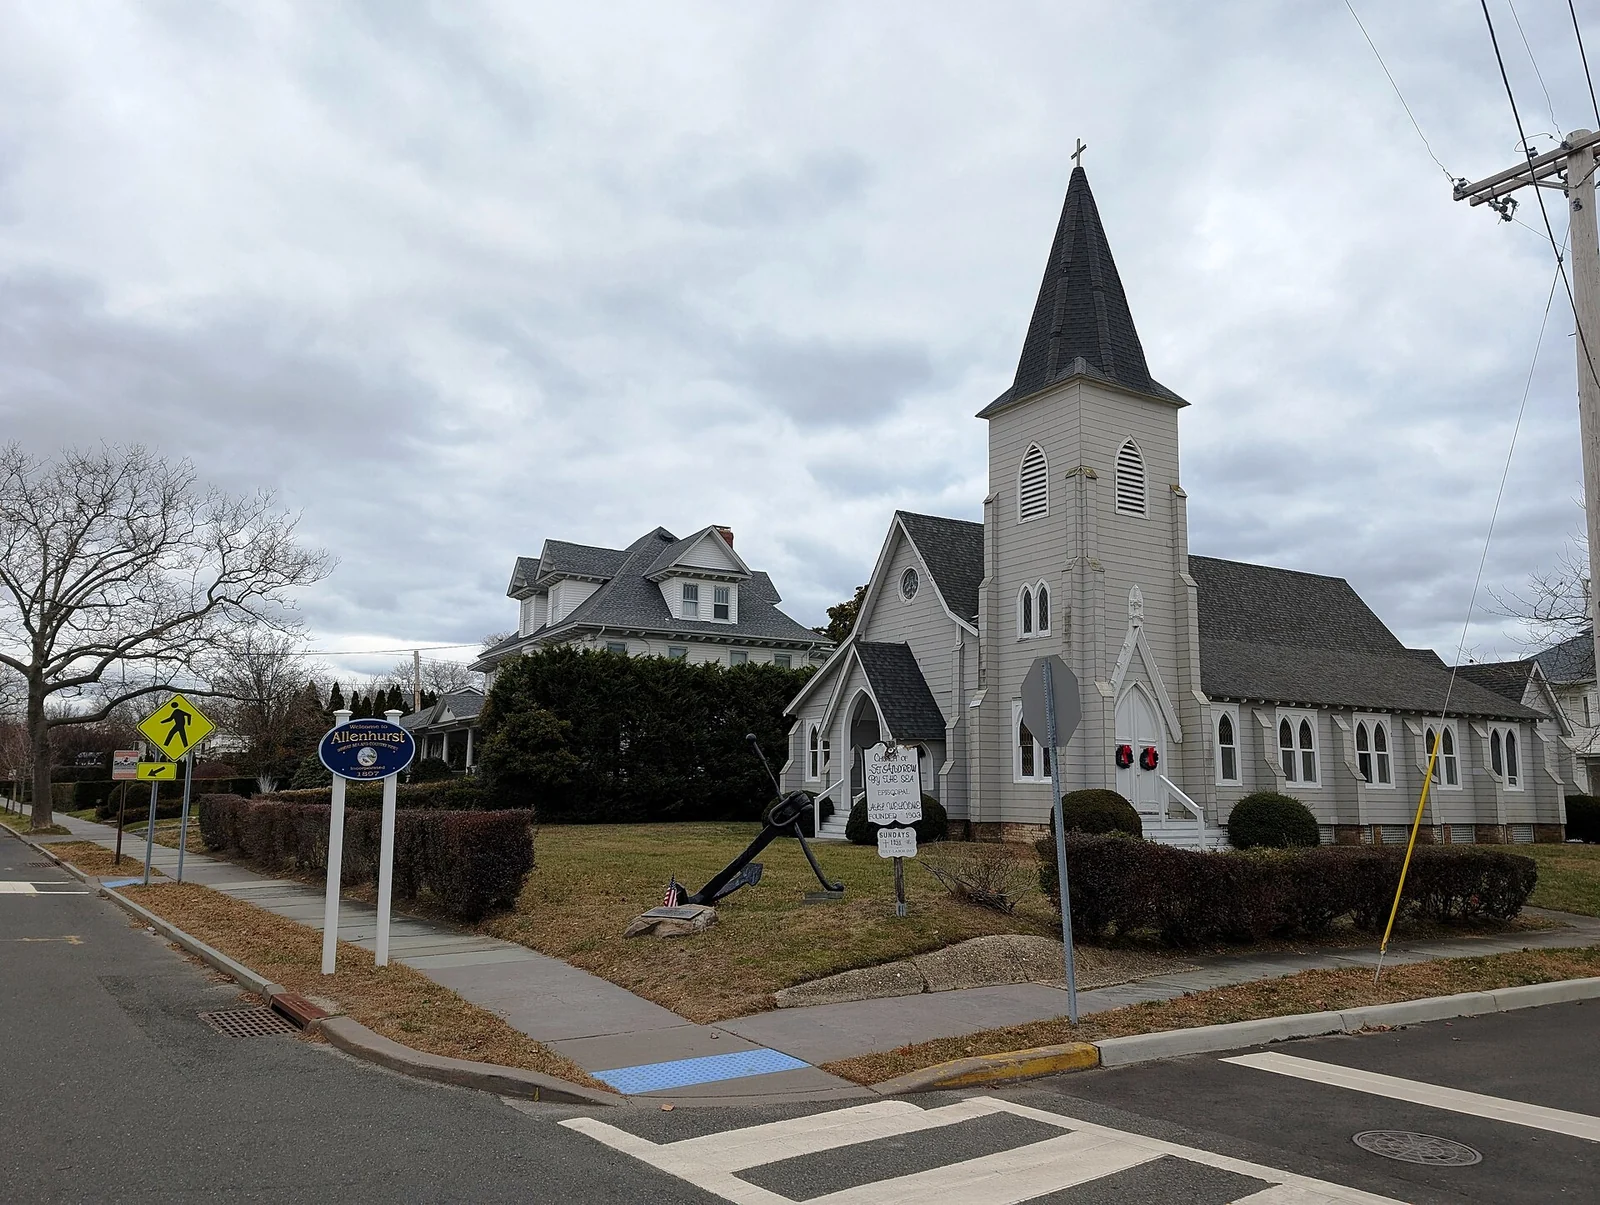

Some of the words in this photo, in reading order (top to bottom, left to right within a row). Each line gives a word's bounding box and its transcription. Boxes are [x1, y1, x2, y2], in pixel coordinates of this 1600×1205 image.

[331, 731, 405, 744] Allenhurst
[882, 763, 917, 774] ANDREW
[868, 775, 880, 786] BY
[882, 775, 898, 783] THE
[901, 775, 914, 783] SEA
[886, 801, 921, 810] WELCOME
[906, 811, 921, 819] 1903
